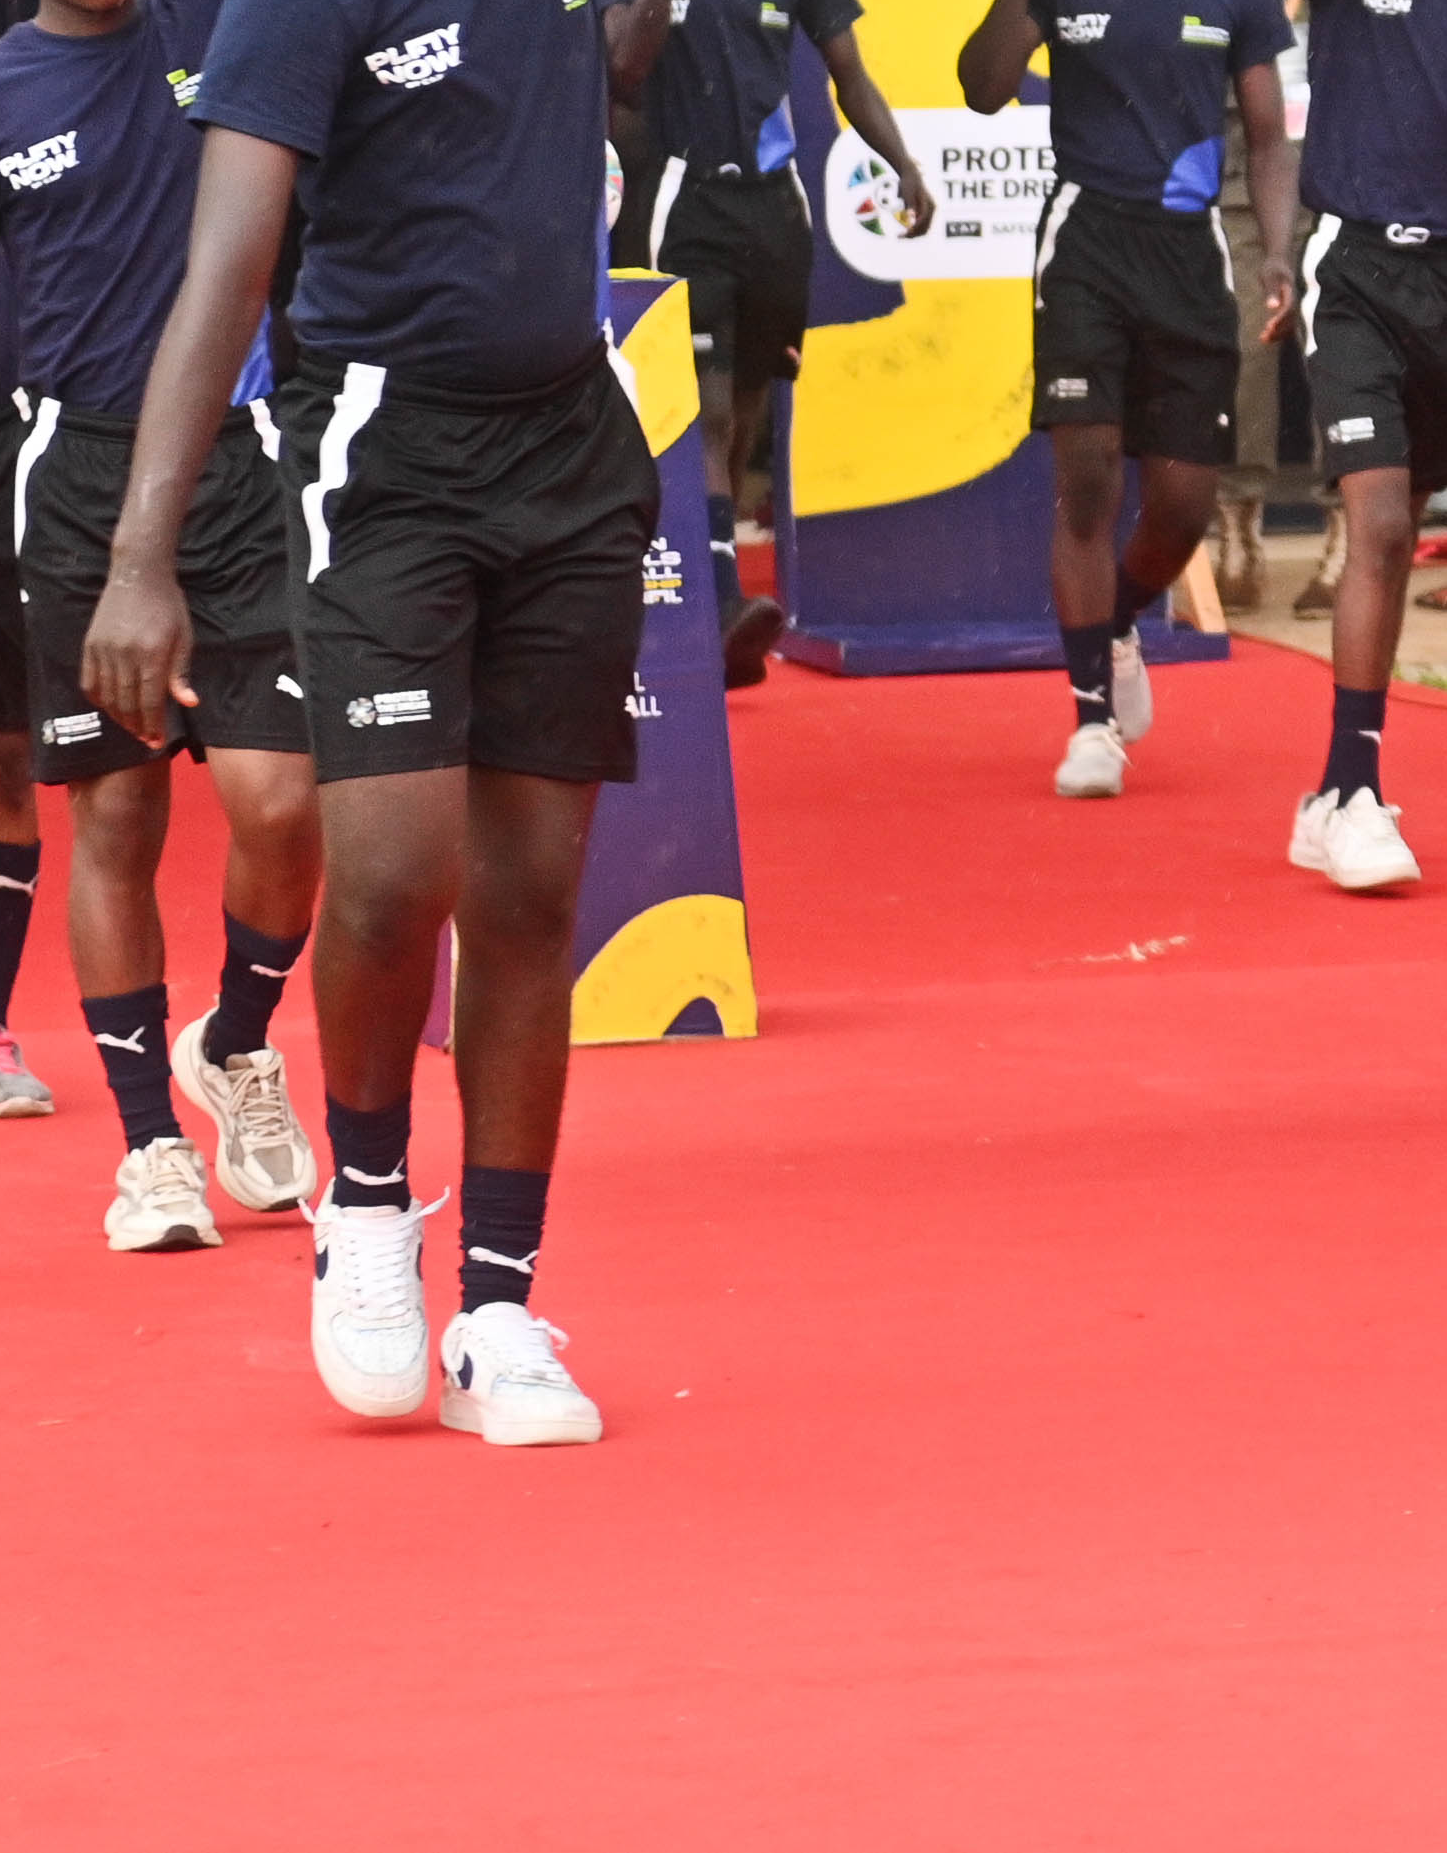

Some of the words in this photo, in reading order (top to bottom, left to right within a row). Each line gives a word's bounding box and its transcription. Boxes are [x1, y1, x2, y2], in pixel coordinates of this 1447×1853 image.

[941, 146, 1056, 172] PROTE
[944, 178, 995, 199] THE
[1003, 178, 1054, 199] DRE
